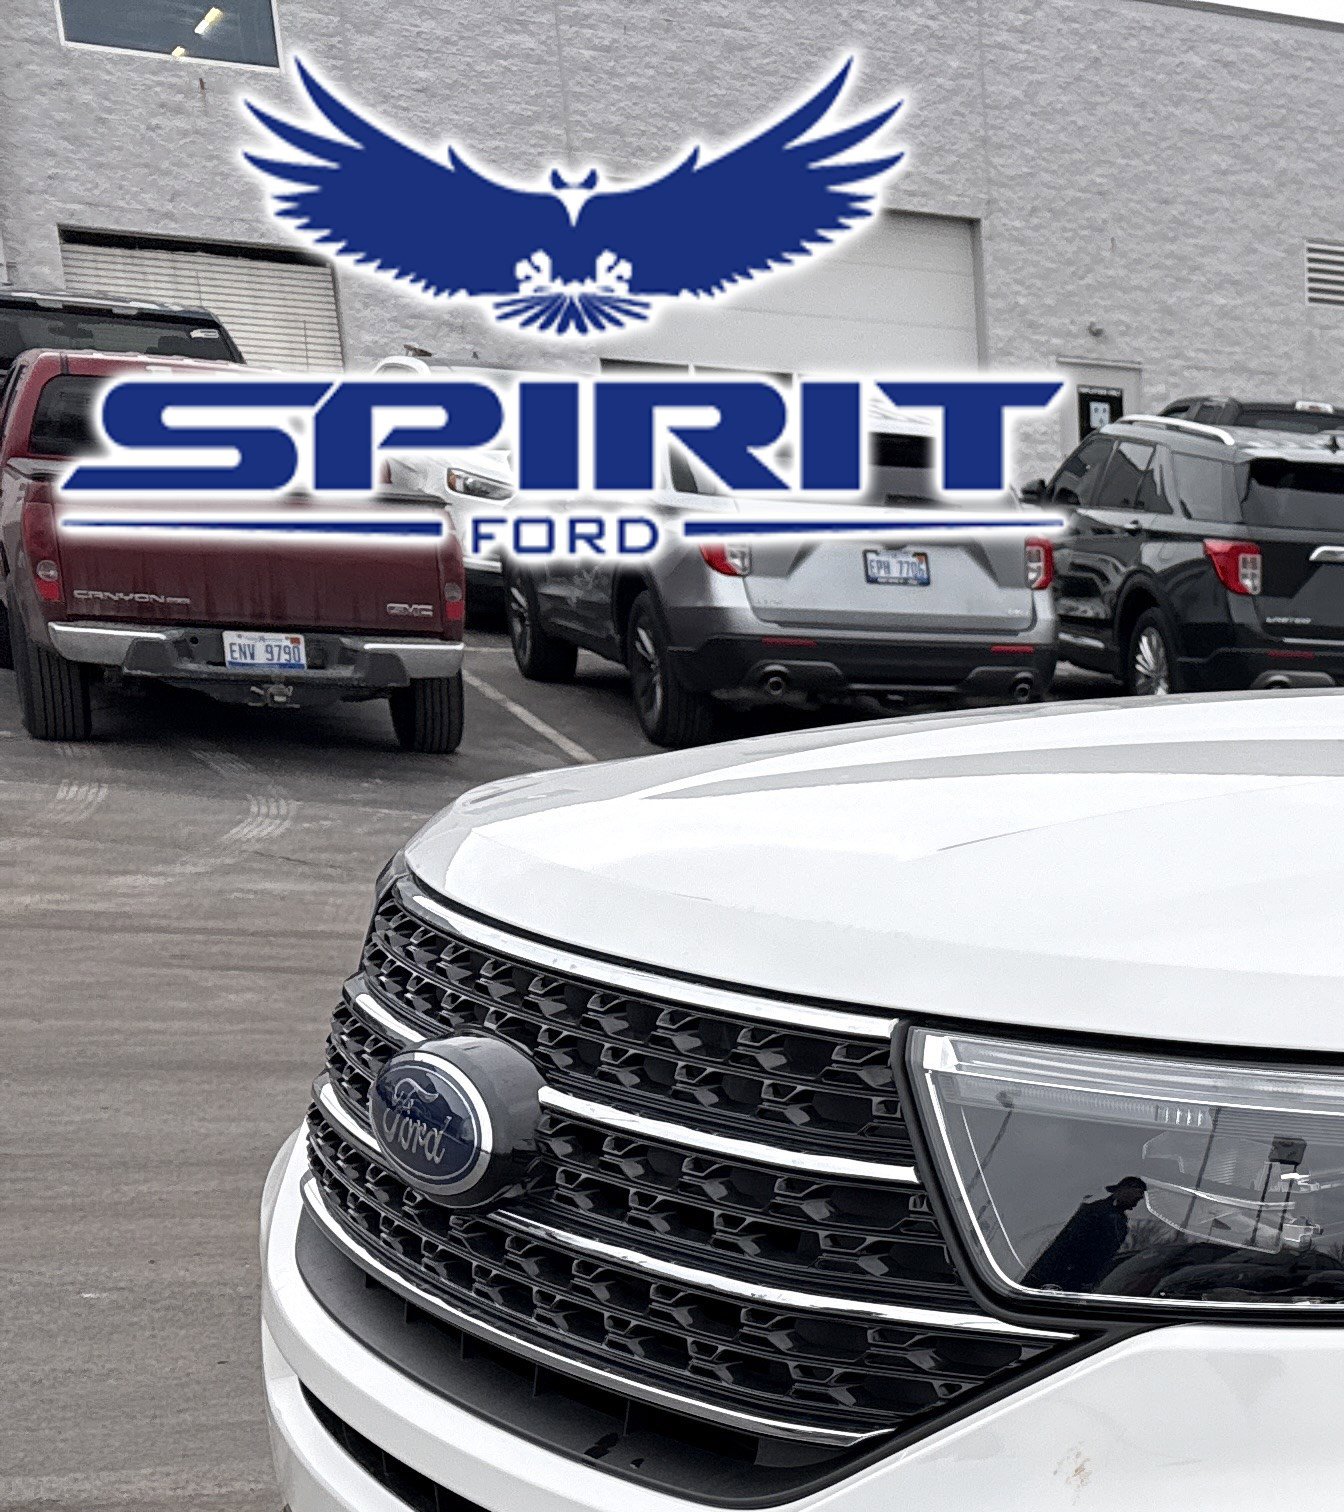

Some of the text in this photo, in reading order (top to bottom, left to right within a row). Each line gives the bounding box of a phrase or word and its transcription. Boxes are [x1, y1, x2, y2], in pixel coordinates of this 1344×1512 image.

[73, 588, 165, 603] CANYON
[386, 602, 433, 617] GMC
[229, 642, 301, 663] ENV 9790
[382, 1076, 454, 1165] Ford
